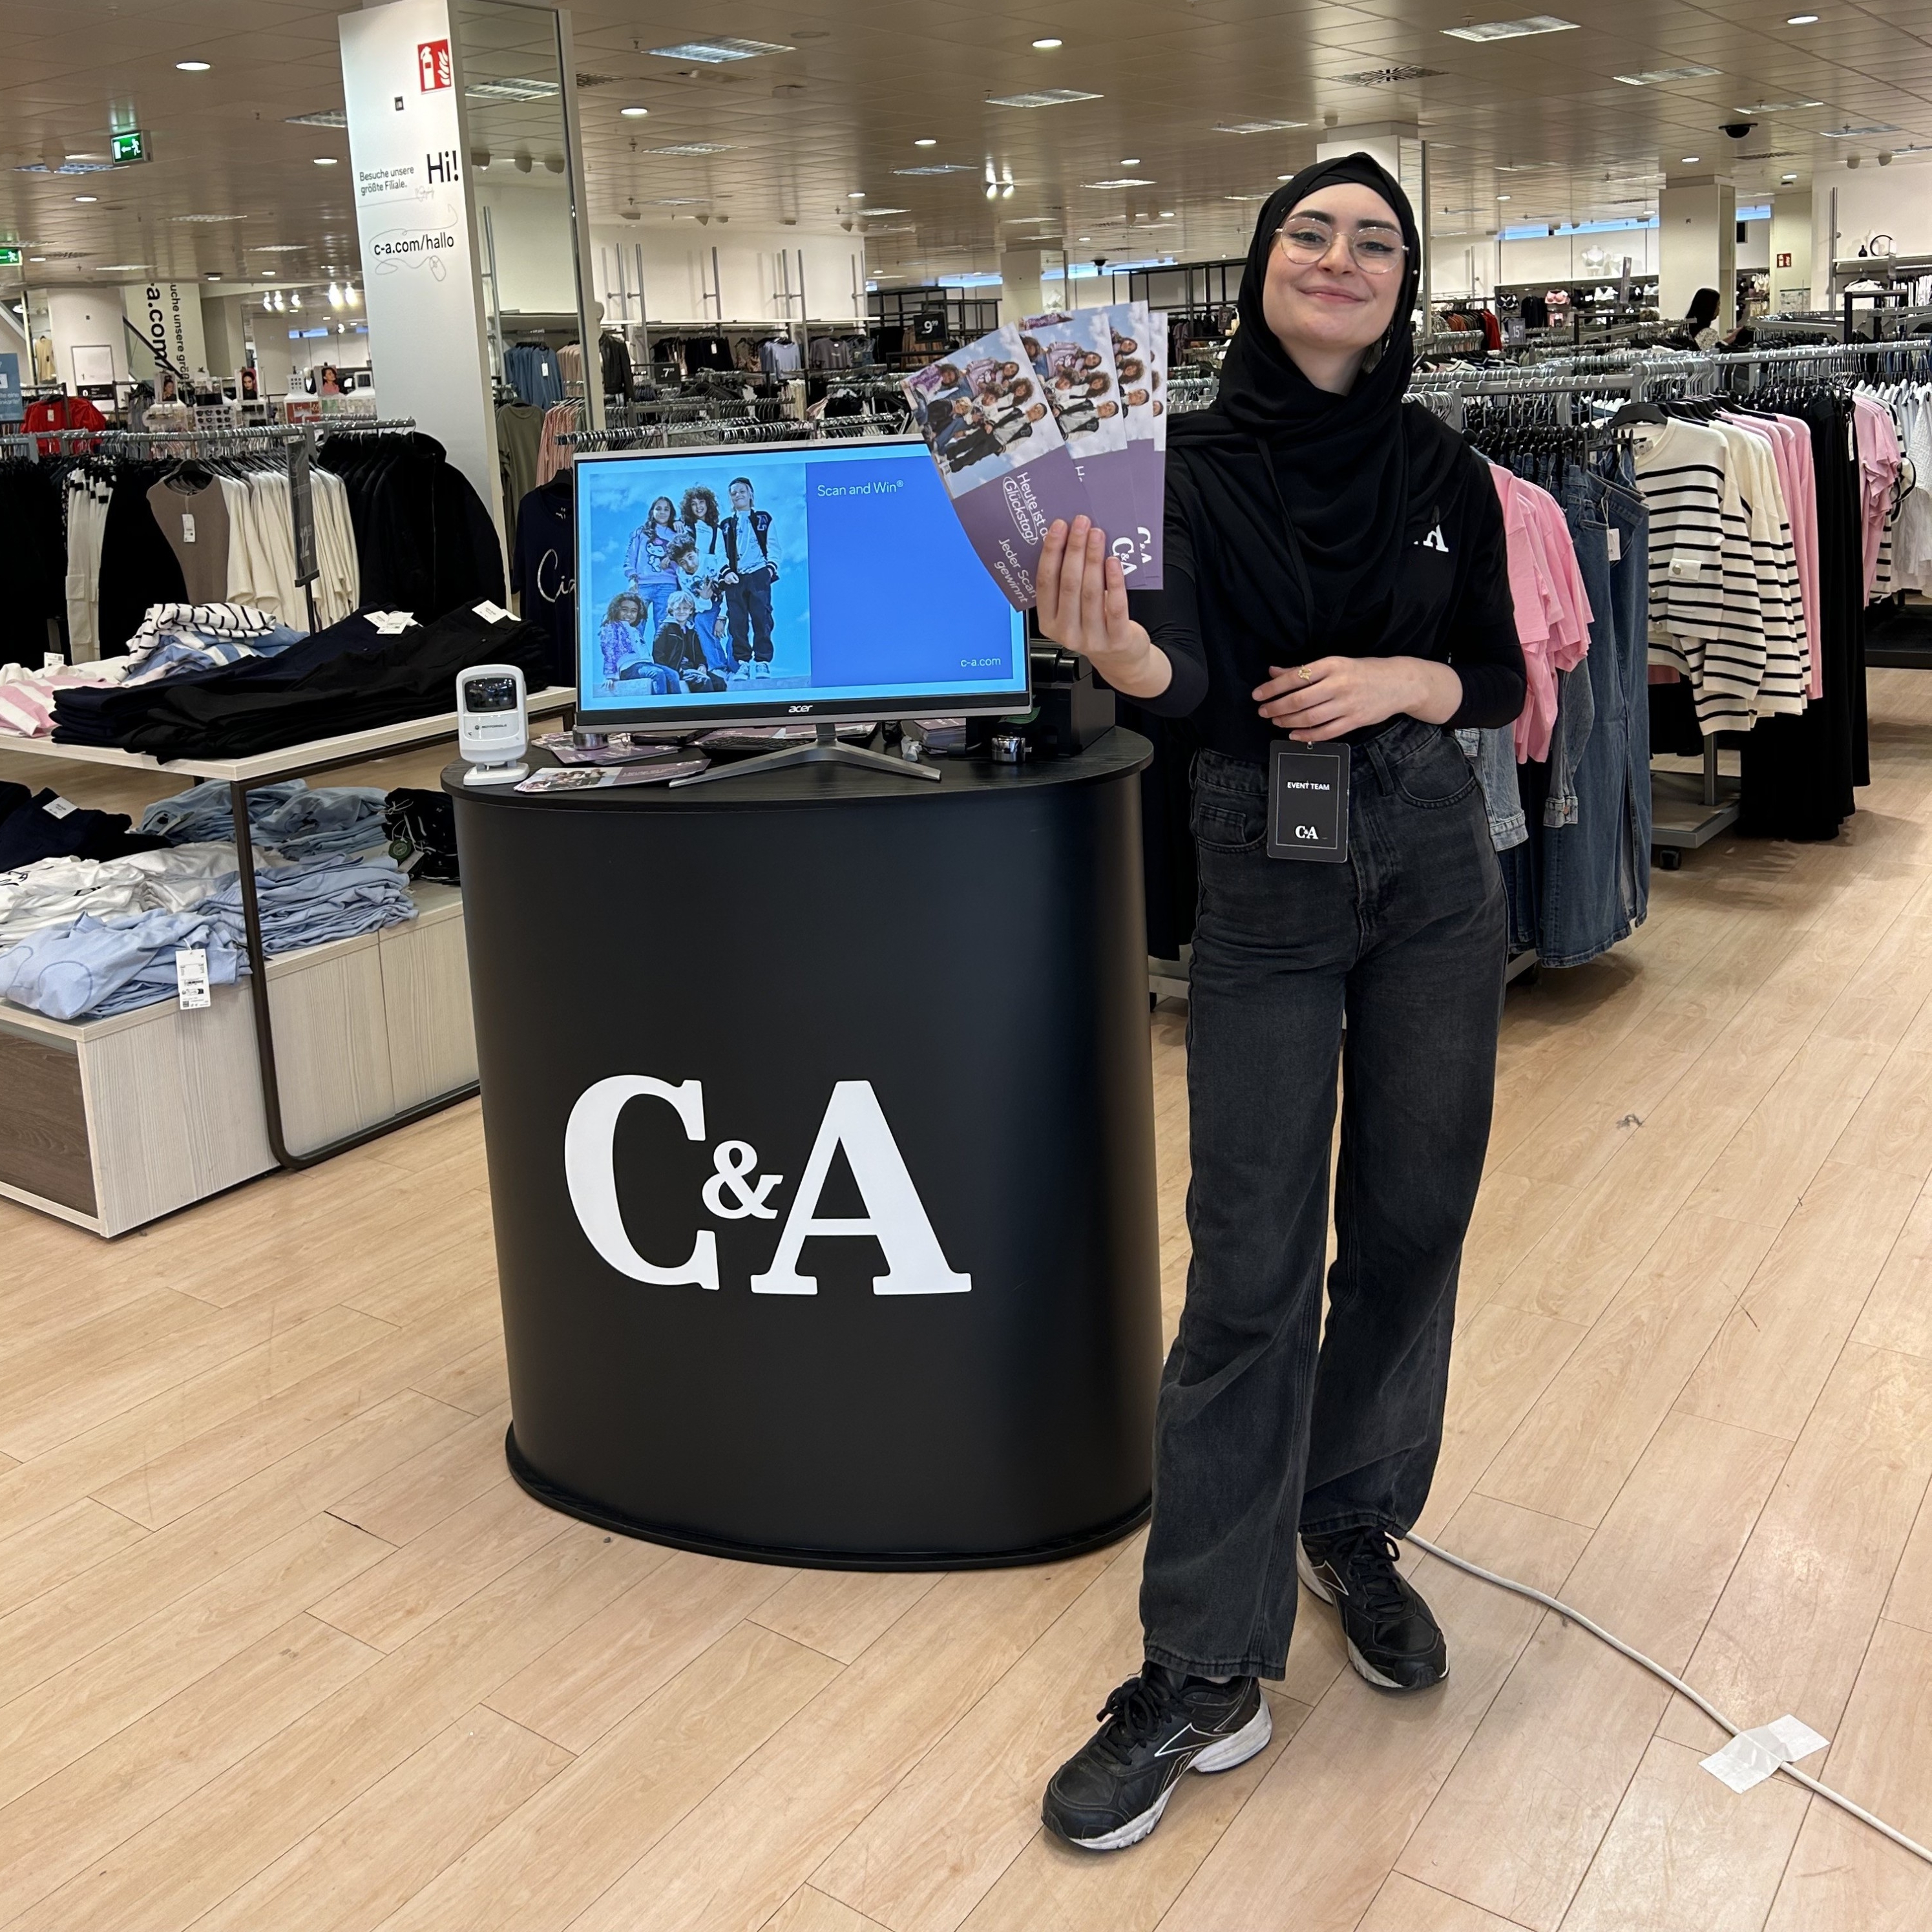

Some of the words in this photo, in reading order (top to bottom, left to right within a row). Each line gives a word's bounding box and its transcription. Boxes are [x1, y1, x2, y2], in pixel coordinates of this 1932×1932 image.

[359, 169, 389, 182] Besuche
[390, 166, 414, 177] unsere
[426, 150, 459, 184] Hi!
[361, 182, 383, 196] größte
[384, 178, 408, 191] Filiale.
[373, 232, 454, 255] c-a.com/hallo
[170, 283, 180, 312] uche
[173, 314, 184, 352] unsere
[817, 485, 846, 497] Scan
[848, 482, 871, 495] and
[1016, 472, 1038, 510] Heute
[1032, 509, 1046, 525] ist
[1003, 479, 1039, 545] Glückstag!
[999, 539, 1022, 569] Jeder
[1017, 569, 1038, 598] Scan
[994, 560, 1029, 604] gewinnt
[960, 658, 1002, 667] c-a.com
[788, 704, 813, 713] acer
[1287, 781, 1309, 790] EVENT
[1295, 825, 1319, 839] C&A
[564, 1075, 972, 1296] C&A
